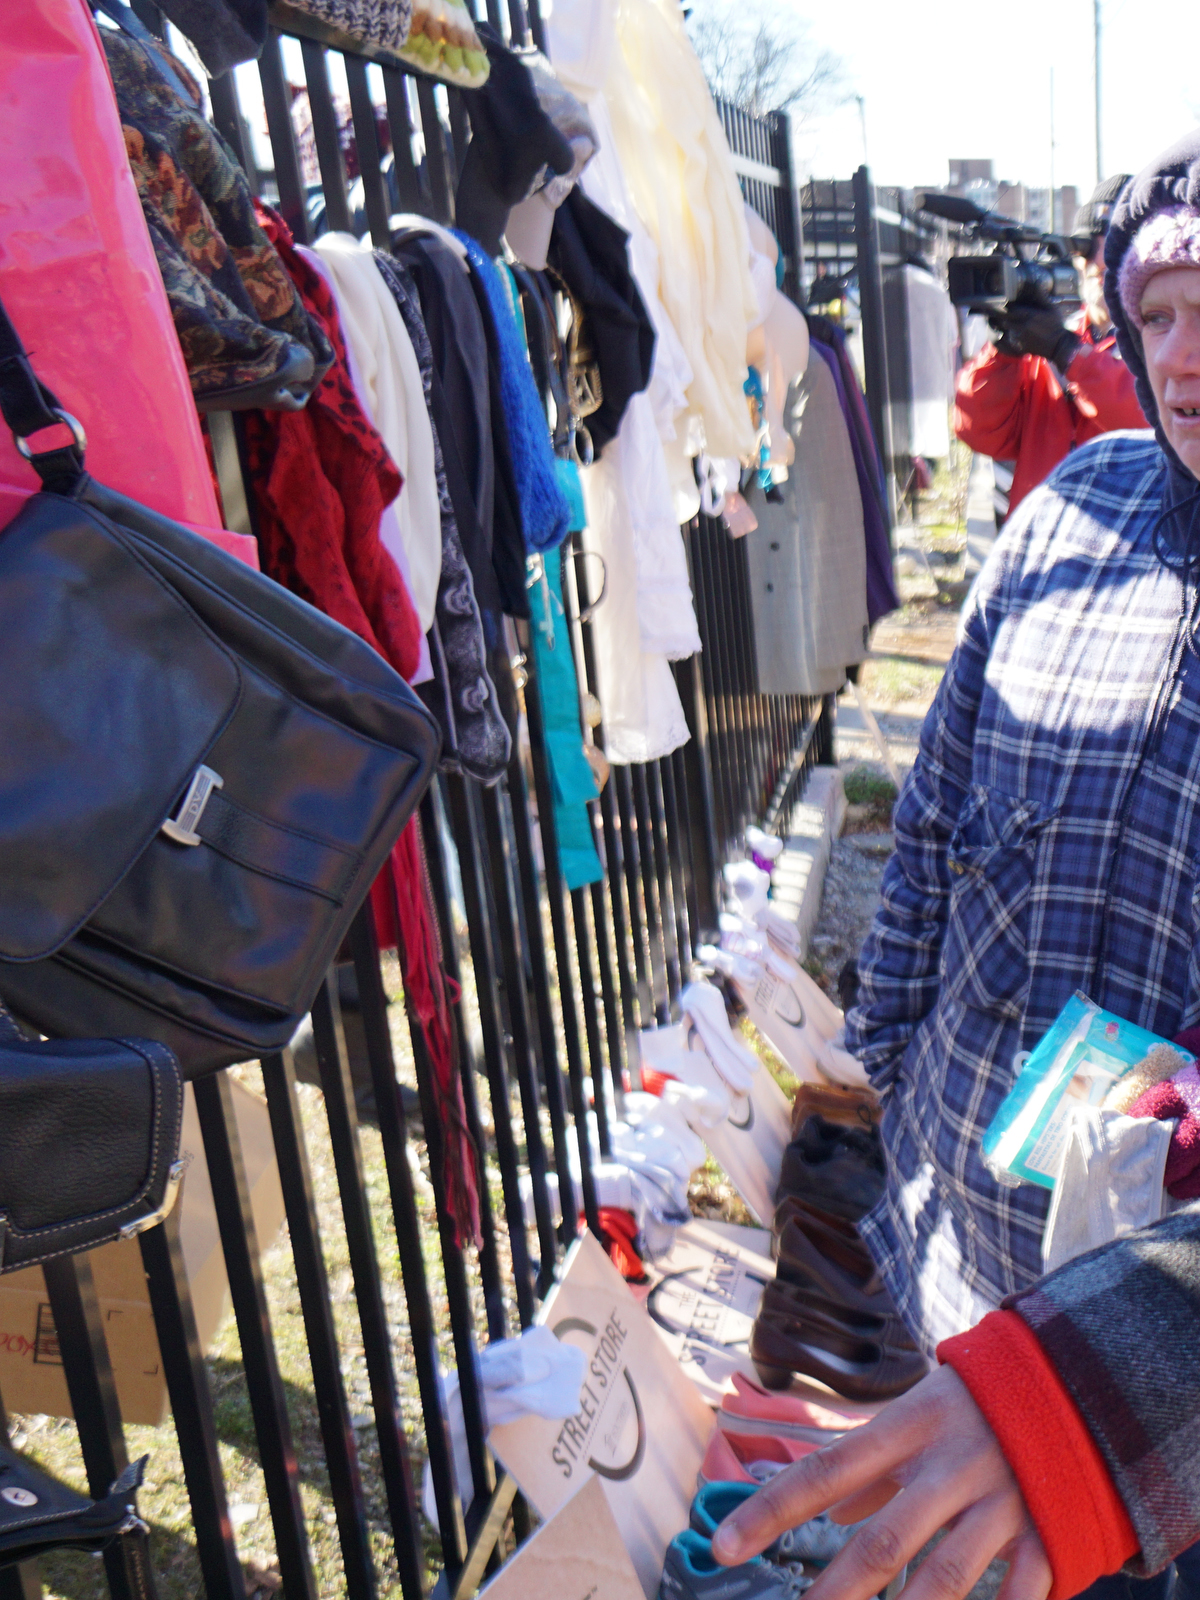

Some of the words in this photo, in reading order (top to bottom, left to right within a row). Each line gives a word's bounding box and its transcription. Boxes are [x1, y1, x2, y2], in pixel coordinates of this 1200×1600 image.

[679, 1299, 724, 1367] STREET
[703, 1248, 740, 1300] STORE
[552, 1381, 600, 1478] STREET
[590, 1306, 628, 1388] STORE
